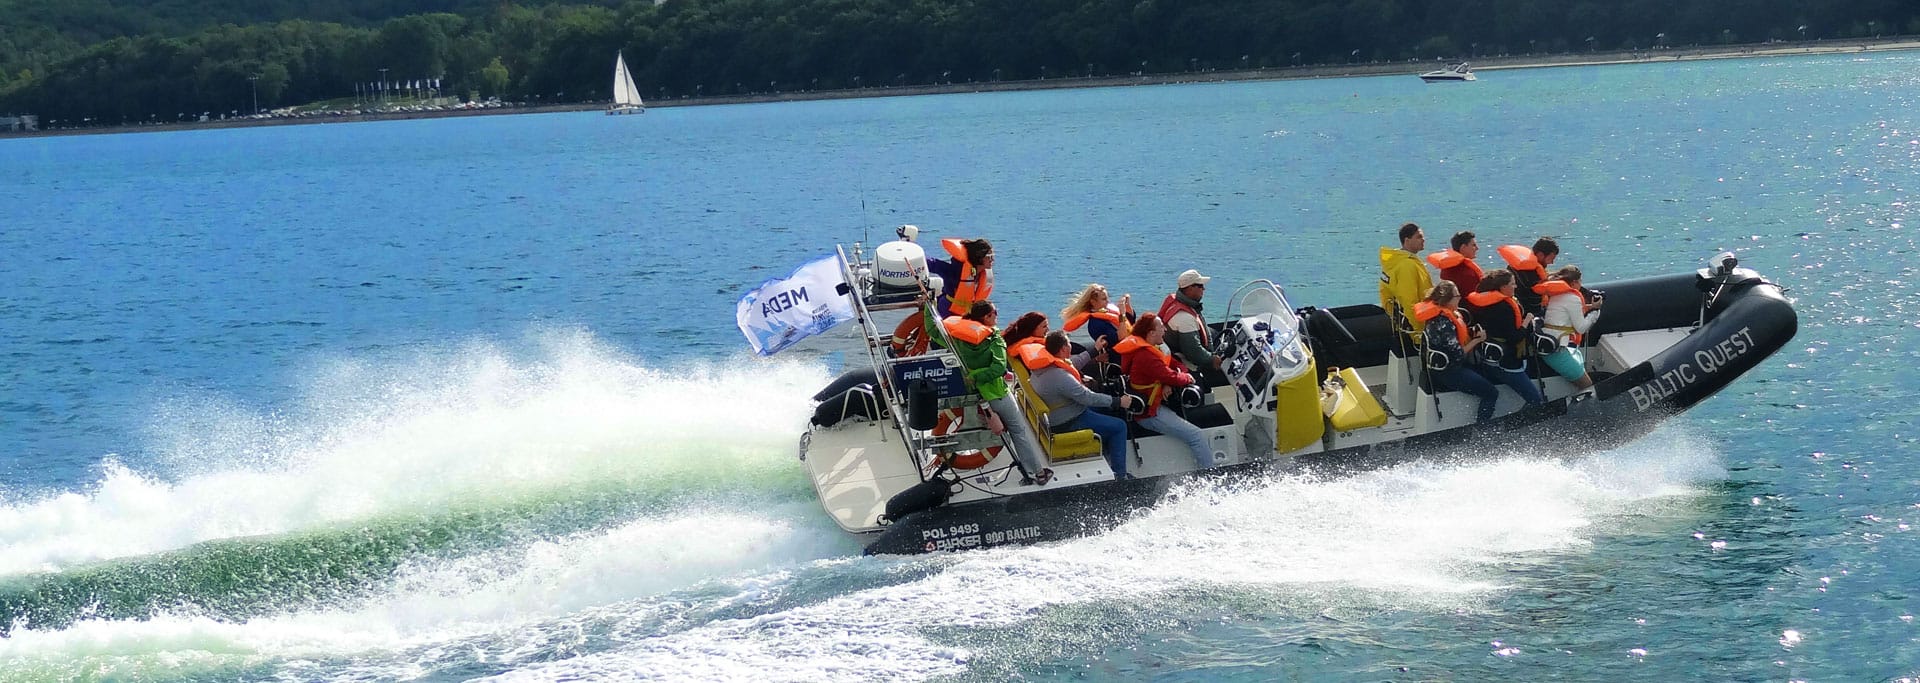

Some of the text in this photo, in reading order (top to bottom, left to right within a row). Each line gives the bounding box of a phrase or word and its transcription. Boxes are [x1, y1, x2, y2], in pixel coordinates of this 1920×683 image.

[925, 367, 953, 378] RIDE
[1628, 326, 1755, 412] BALTIC QUEST
[922, 523, 980, 540] POL 9493
[936, 525, 1041, 551] PARKER 900 BALTIC
